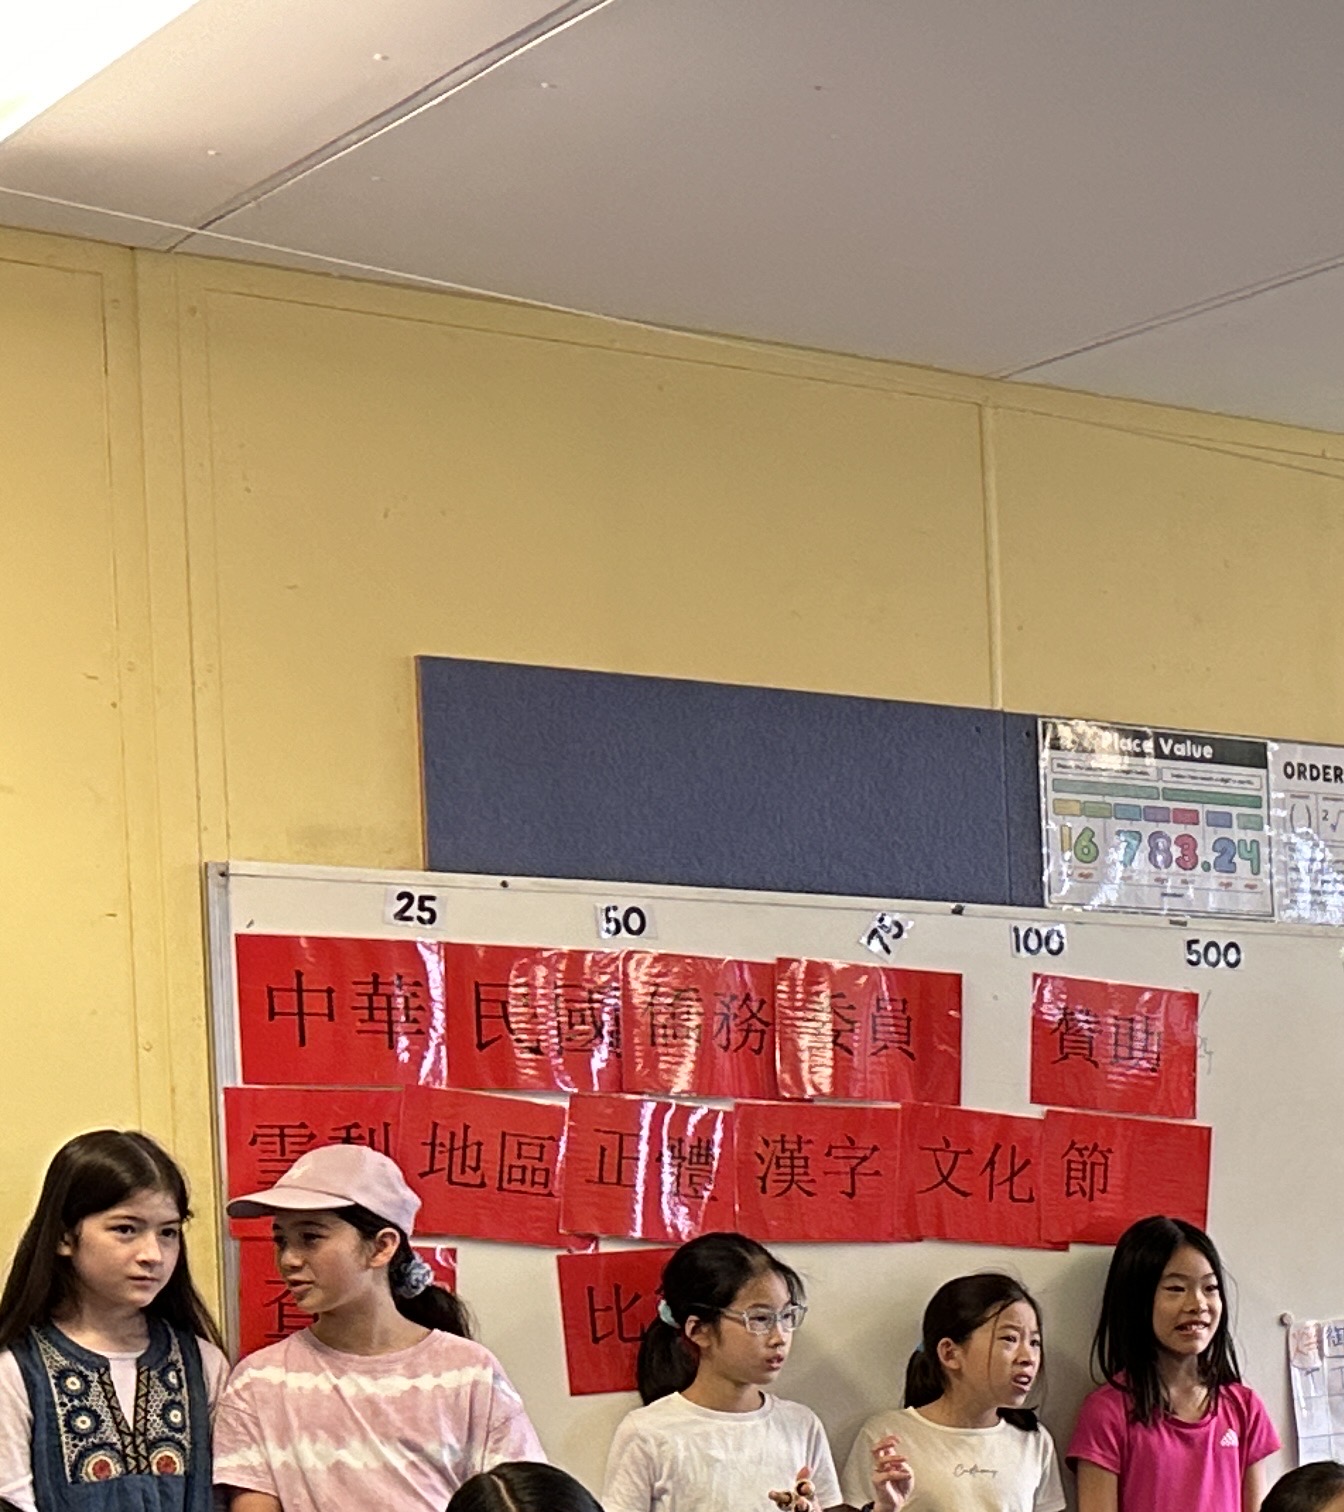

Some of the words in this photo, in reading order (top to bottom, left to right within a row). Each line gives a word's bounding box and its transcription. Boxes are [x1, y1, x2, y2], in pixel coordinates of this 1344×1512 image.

[1159, 737, 1214, 759] Value
[1282, 760, 1344, 785] ORDER
[394, 891, 437, 926] 25
[602, 904, 647, 937] 50
[1013, 926, 1065, 957] 100
[1185, 939, 1242, 969] 500
